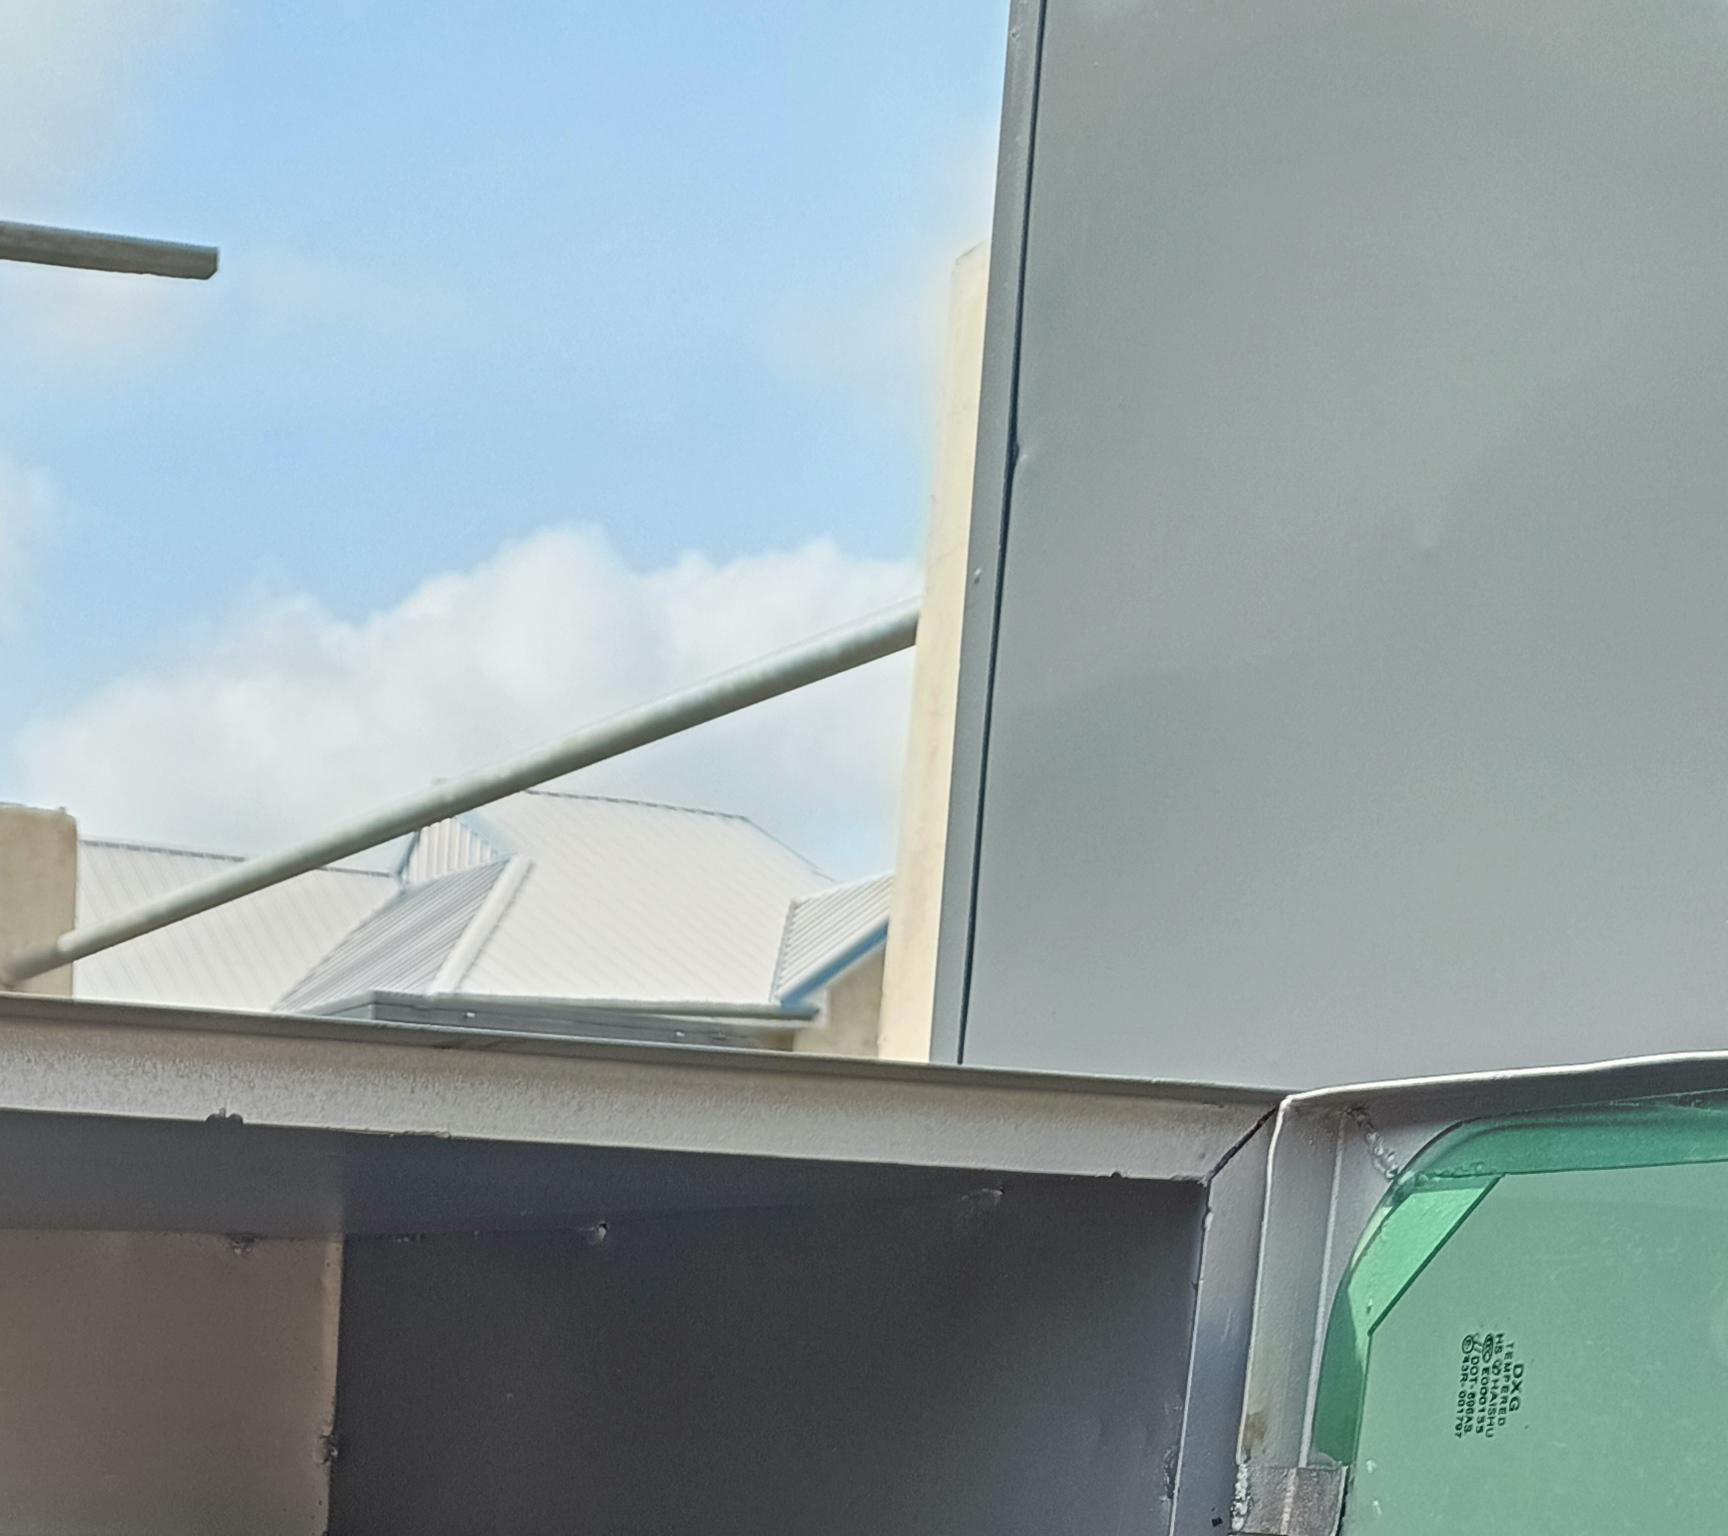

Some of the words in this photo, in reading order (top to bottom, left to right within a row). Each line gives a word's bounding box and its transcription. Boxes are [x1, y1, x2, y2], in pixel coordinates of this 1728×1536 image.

[1485, 1378, 1500, 1438] HAISHU
[1497, 1342, 1514, 1426] TEMPERED
[1509, 1364, 1524, 1412] DXG
